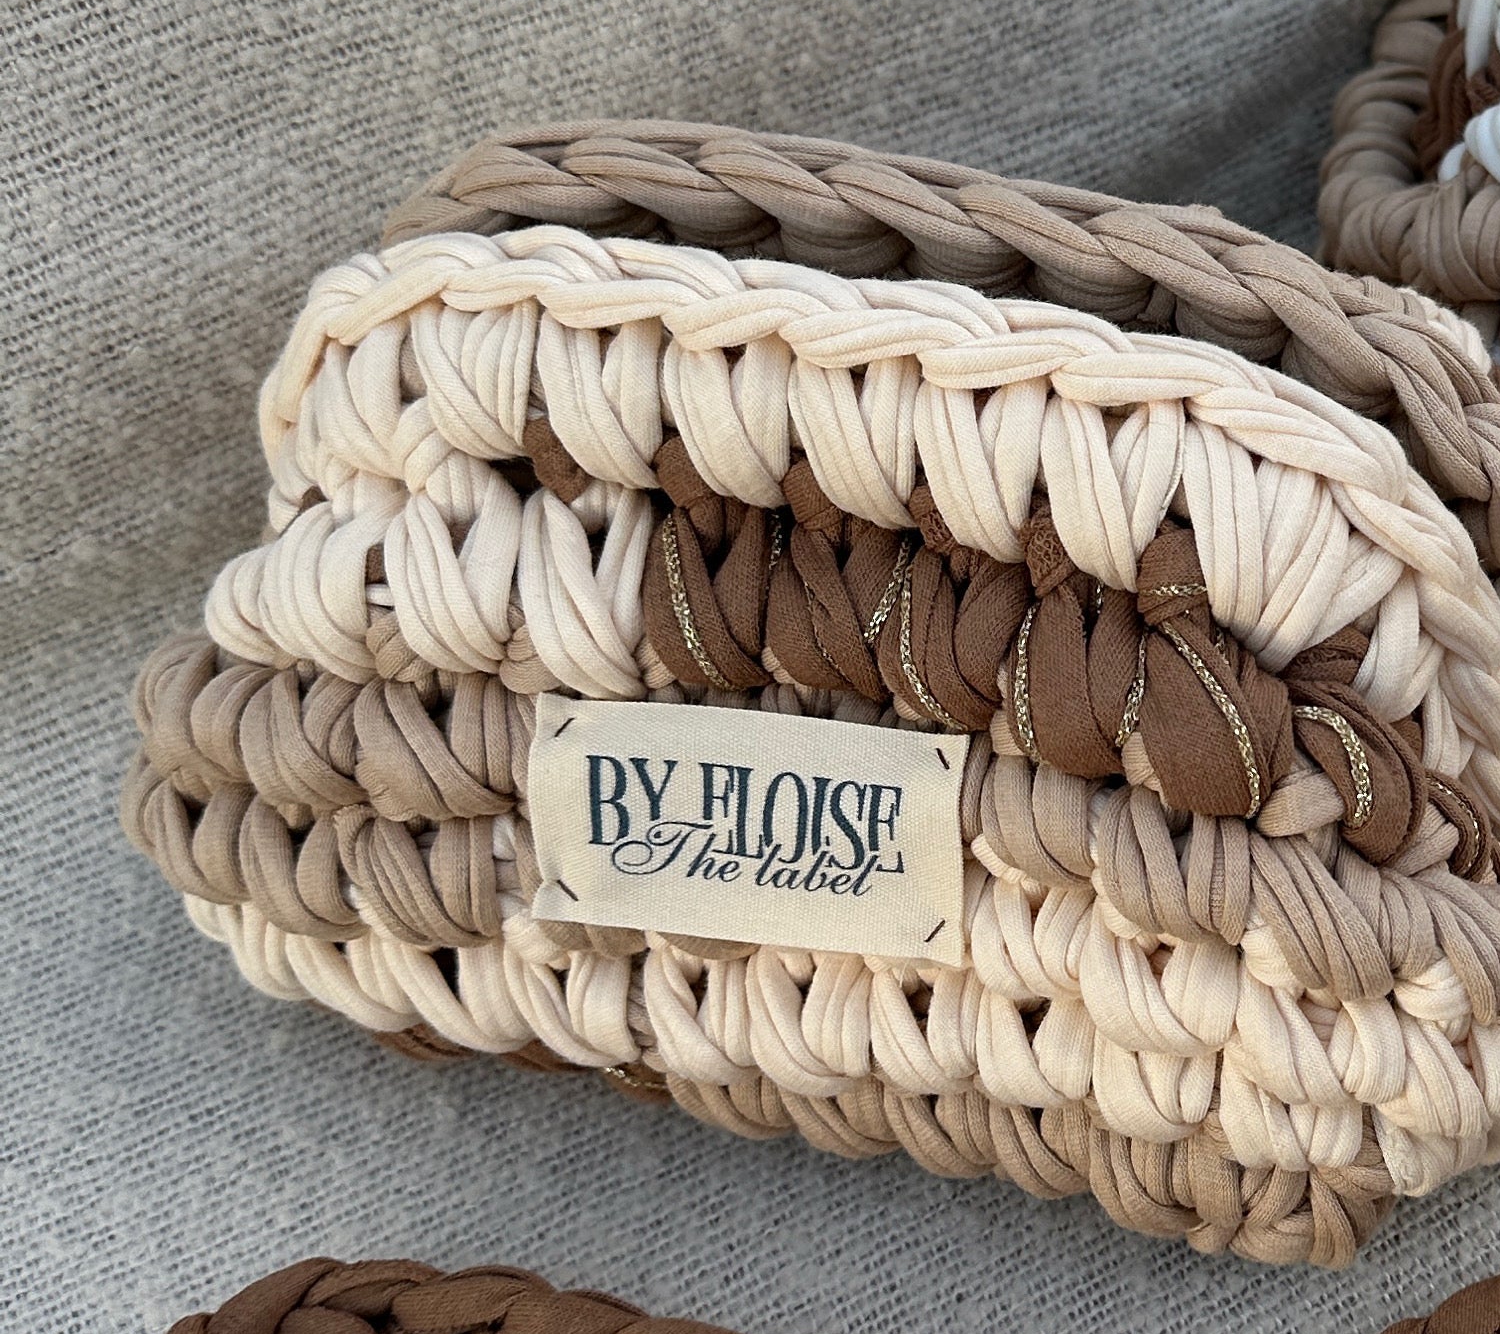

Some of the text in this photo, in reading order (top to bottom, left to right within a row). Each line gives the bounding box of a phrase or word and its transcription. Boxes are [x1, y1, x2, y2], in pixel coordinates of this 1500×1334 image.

[585, 754, 905, 874] BY ELOISE
[611, 820, 880, 897] The label
